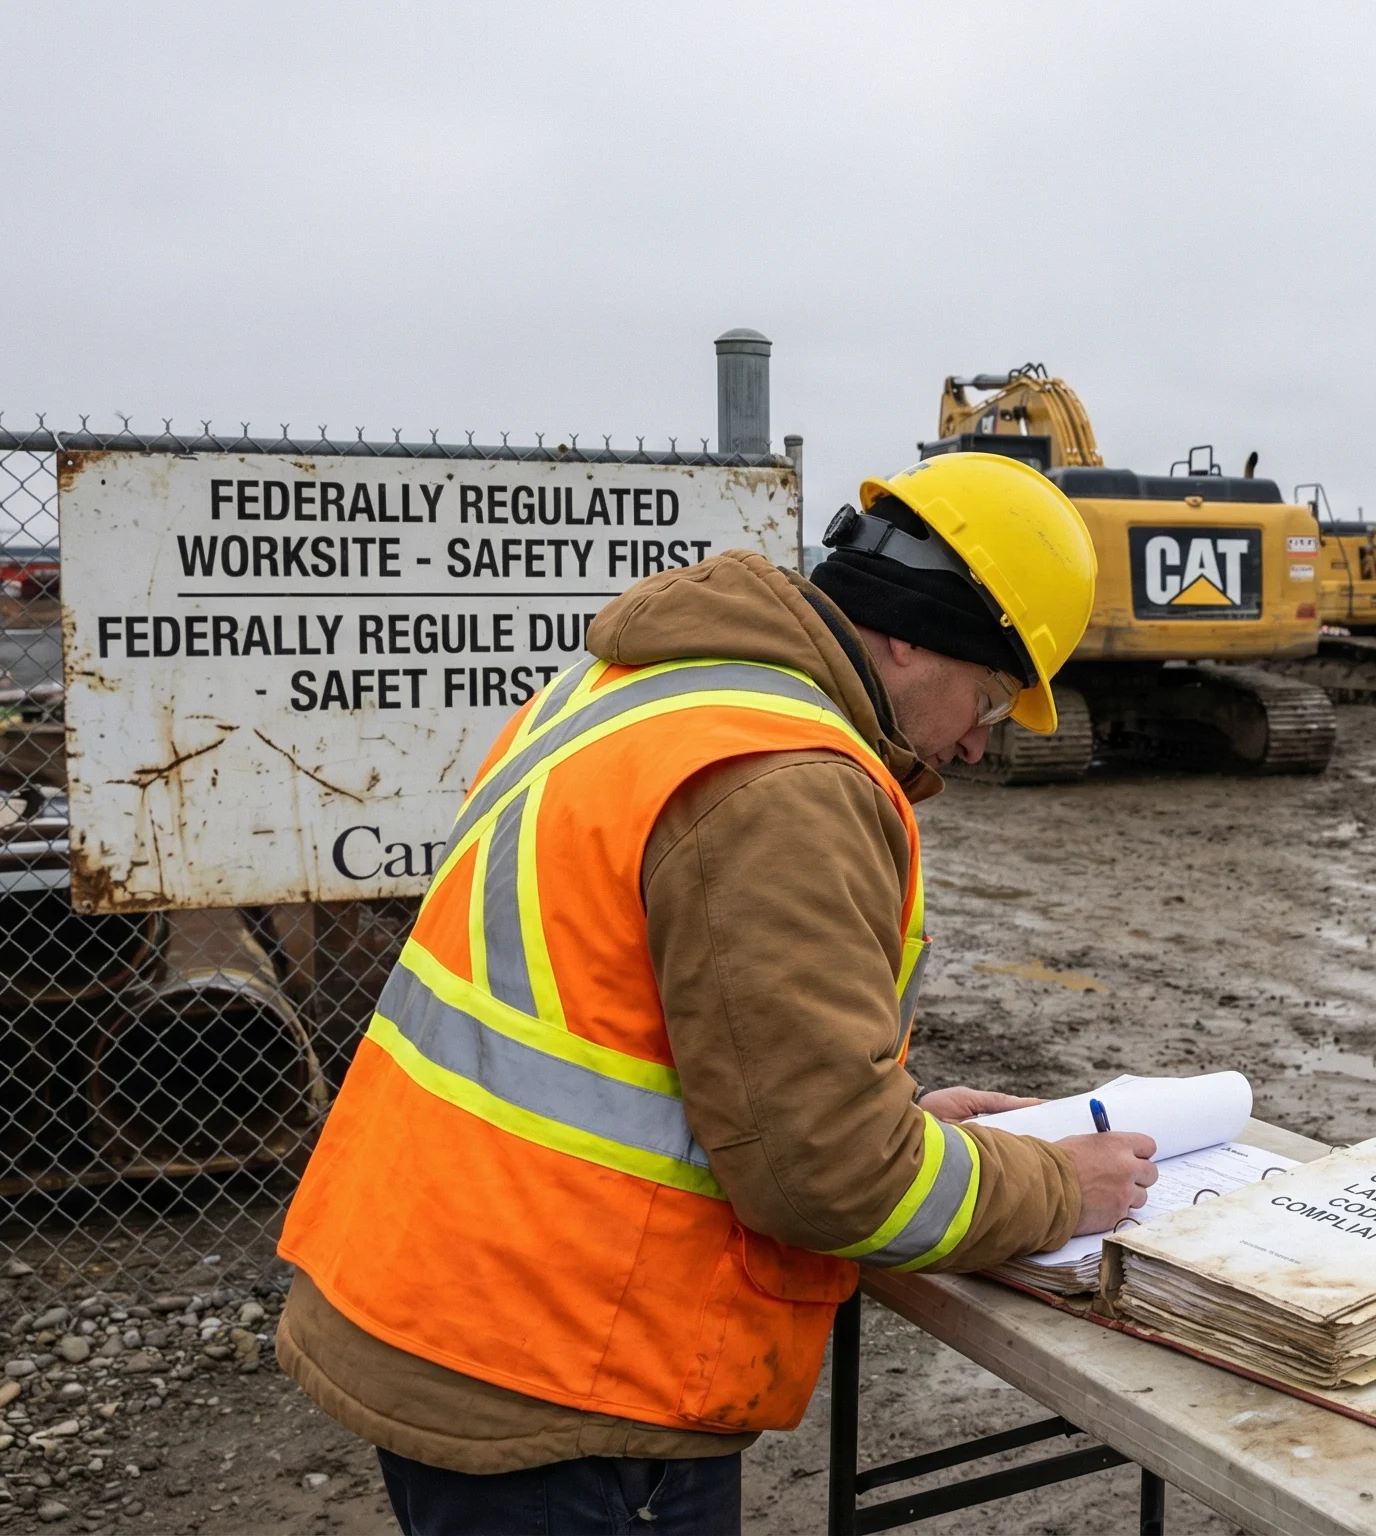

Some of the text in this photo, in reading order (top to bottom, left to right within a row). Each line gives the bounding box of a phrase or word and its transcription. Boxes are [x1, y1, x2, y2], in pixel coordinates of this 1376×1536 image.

[211, 480, 679, 526] FEDERALLY REGULATED
[177, 535, 712, 578] WORKSITE - SAFETY FIRST
[1145, 535, 1249, 606] CAT
[98, 615, 344, 659] FEDERALLY
[360, 614, 515, 654] REGULE
[291, 669, 428, 711] SAFET
[445, 667, 559, 708] FIRST
